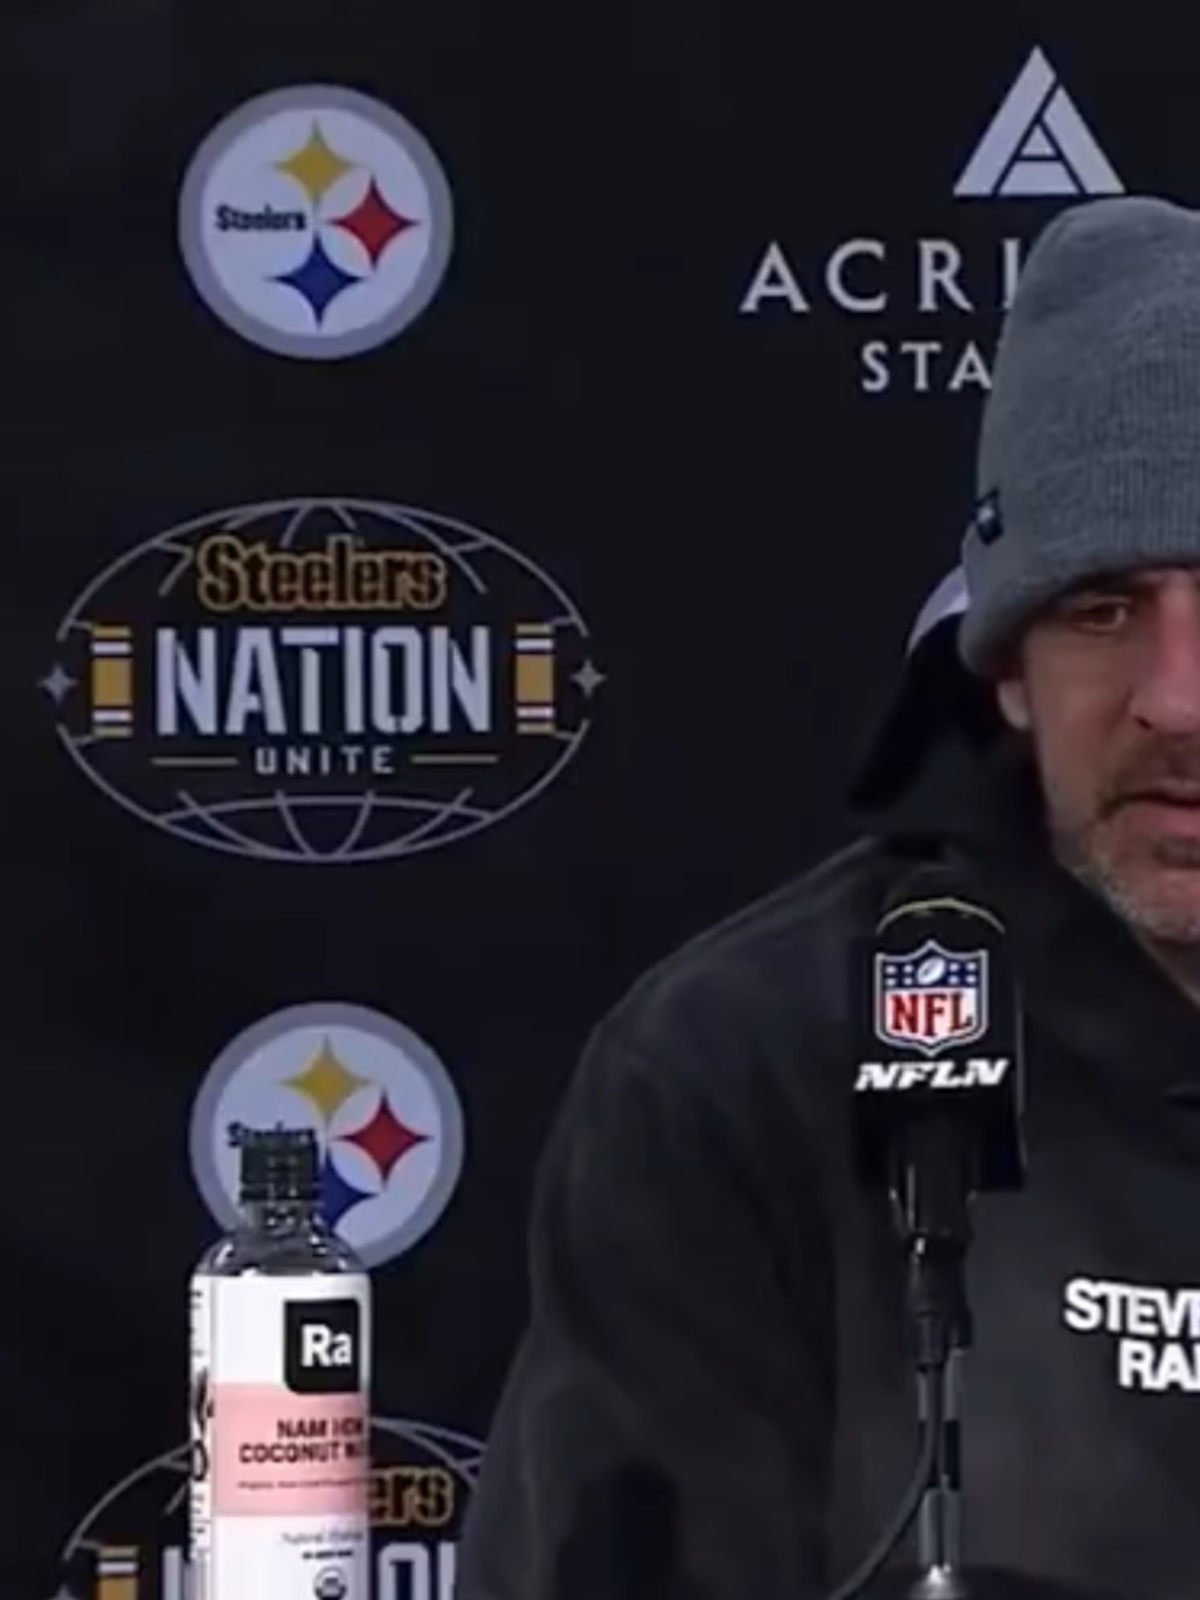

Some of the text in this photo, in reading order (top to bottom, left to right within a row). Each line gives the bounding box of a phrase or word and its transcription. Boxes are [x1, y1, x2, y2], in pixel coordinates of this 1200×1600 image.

[214, 203, 307, 233] Steelers
[198, 534, 448, 611] Steelers
[156, 625, 491, 736] NATION
[255, 745, 395, 776] UNITE
[889, 992, 974, 1038] NFL
[854, 1057, 1009, 1091] NFLN
[301, 1324, 353, 1367] Ra
[239, 1442, 340, 1463] COCONUT
